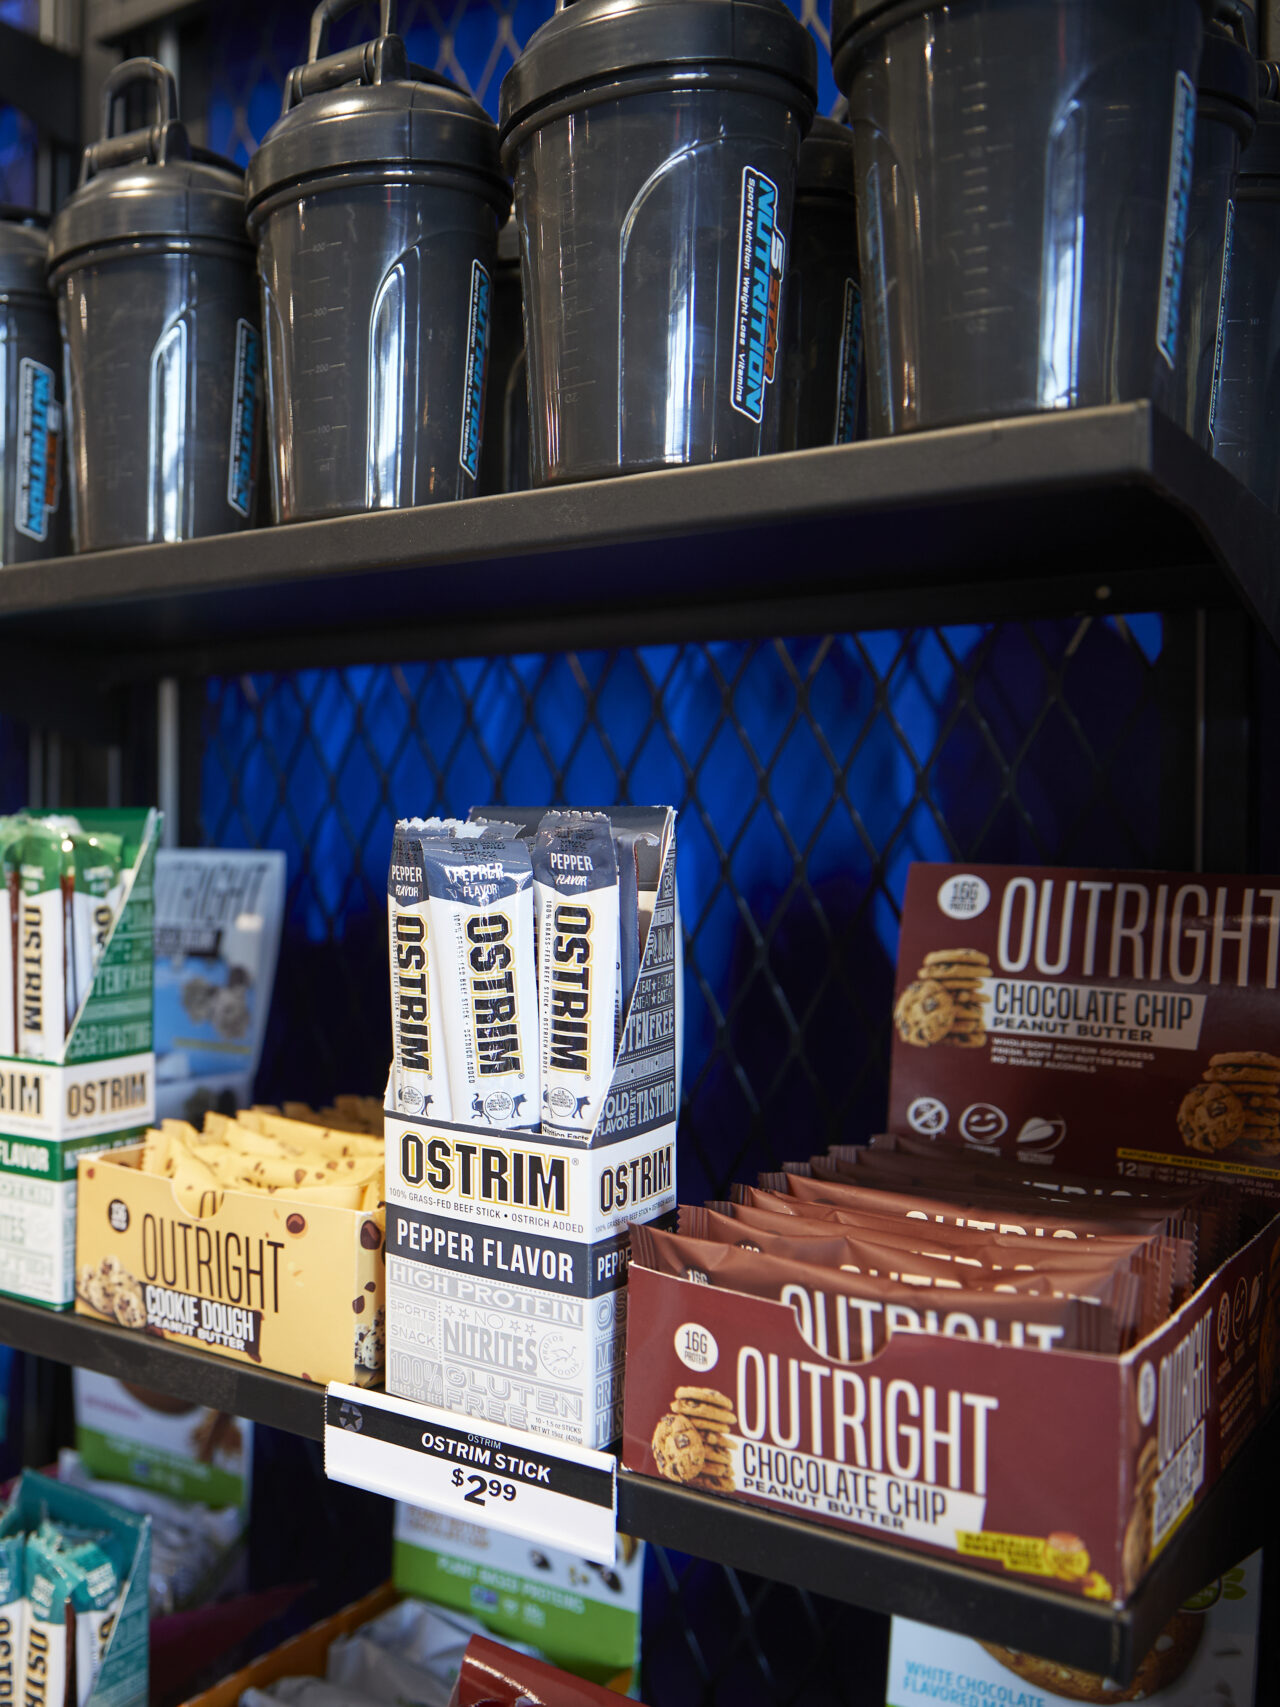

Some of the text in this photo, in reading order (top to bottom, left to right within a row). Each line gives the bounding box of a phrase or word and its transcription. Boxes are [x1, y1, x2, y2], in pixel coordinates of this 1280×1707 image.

[735, 177, 756, 402] Sports Nutrition Weight Loss Vitamins
[745, 179, 775, 414] NUTRITION
[467, 271, 489, 473] NUTRITION
[391, 864, 423, 883] PEPPER
[550, 852, 594, 871] PEPPER
[556, 873, 588, 887] FLAVOR
[395, 885, 419, 897] FLAVOR
[463, 884, 500, 898] FLAVOR
[645, 925, 674, 967] RIM
[996, 876, 1280, 990] OUTRIGHT
[397, 915, 431, 1073] OSTRIM
[465, 914, 521, 1076] OSTRIM
[551, 904, 593, 1072] OSTRIM
[994, 982, 1193, 1031] CHOCOLATE CHIP
[650, 1008, 674, 1040] FREE
[992, 1016, 1153, 1043] PEANUT BUTTER
[68, 1072, 147, 1118] OSTRIM
[466, 1061, 476, 1085] ADDED
[636, 1080, 674, 1125] TASTING
[595, 1114, 630, 1138] FLAVOR
[401, 1133, 567, 1213] OSTRIM
[599, 1146, 673, 1215] OSTRIM
[1117, 1161, 1138, 1177] 12
[389, 1187, 584, 1234] 100% GRASS-FED BEEF STICK OSTRICH ADDED
[142, 1213, 286, 1314] OUTRIGHT
[396, 1218, 574, 1284] PEPPER FLAVOR
[597, 1246, 632, 1283] PEPPE
[145, 1284, 255, 1343] COOKIE DOUGH
[390, 1301, 437, 1322] SPORTS
[391, 1266, 449, 1295] HIGH
[456, 1279, 584, 1325] PROTEIN
[146, 1313, 246, 1352] PEANUT BUTTER
[390, 1324, 436, 1348] SNACK
[474, 1310, 505, 1330] NO
[683, 1329, 709, 1354] 16G
[443, 1317, 538, 1377] NITRITES
[596, 1331, 627, 1373] MEA
[683, 1350, 709, 1366] PROTEIN
[390, 1350, 443, 1396] 100%
[445, 1363, 583, 1422] GLUTEN
[595, 1373, 626, 1412] GREA
[445, 1386, 529, 1432] FREE
[530, 1424, 542, 1434] NET
[561, 1424, 583, 1435] STICKS
[736, 1345, 999, 1496] OUTRIGHT
[420, 1432, 552, 1484] OSTRIM STICK
[467, 1433, 502, 1451] OSTRIM
[741, 1442, 947, 1526] CHOCOLATE CHIP
[742, 1477, 906, 1532] PEANUT BUTTER
[903, 1674, 979, 1707] FLAVORED
[904, 1659, 1046, 1707] WHITE CHOCOLATE
